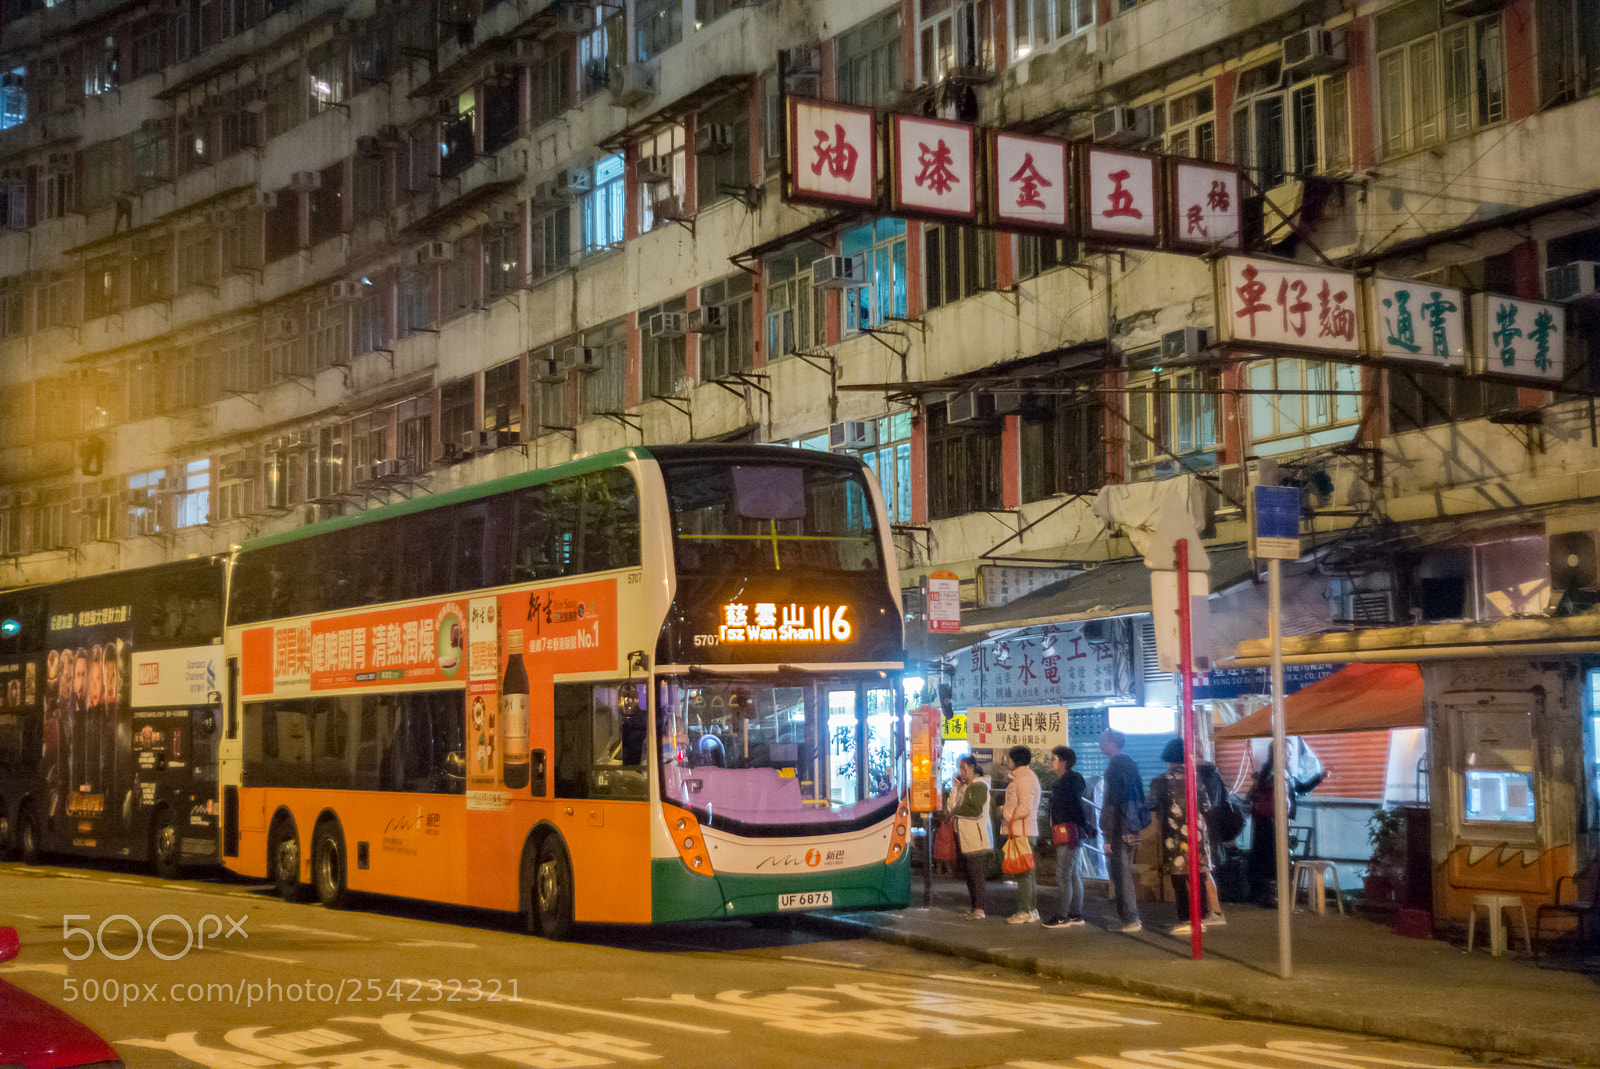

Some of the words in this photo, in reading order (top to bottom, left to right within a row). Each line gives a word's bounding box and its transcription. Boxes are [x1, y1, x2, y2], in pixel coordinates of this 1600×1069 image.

[1235, 264, 1355, 342] 車仔麵
[1383, 290, 1457, 359] 通宵
[1493, 303, 1557, 373] 營業
[628, 573, 642, 584] 5707
[725, 603, 804, 627] 慈雲山
[813, 605, 851, 640] 116
[577, 620, 599, 648] No.1
[694, 635, 718, 646] 5707
[720, 626, 745, 642] Tsz
[747, 626, 777, 641] Wan
[779, 625, 814, 640] Shan
[312, 627, 366, 673] 健脾開胃
[372, 619, 435, 667] 清熱潤燥
[995, 711, 1061, 732] 豐達西藥房
[826, 850, 845, 860] 新巴
[782, 895, 796, 906] UF
[800, 893, 829, 905] 6876
